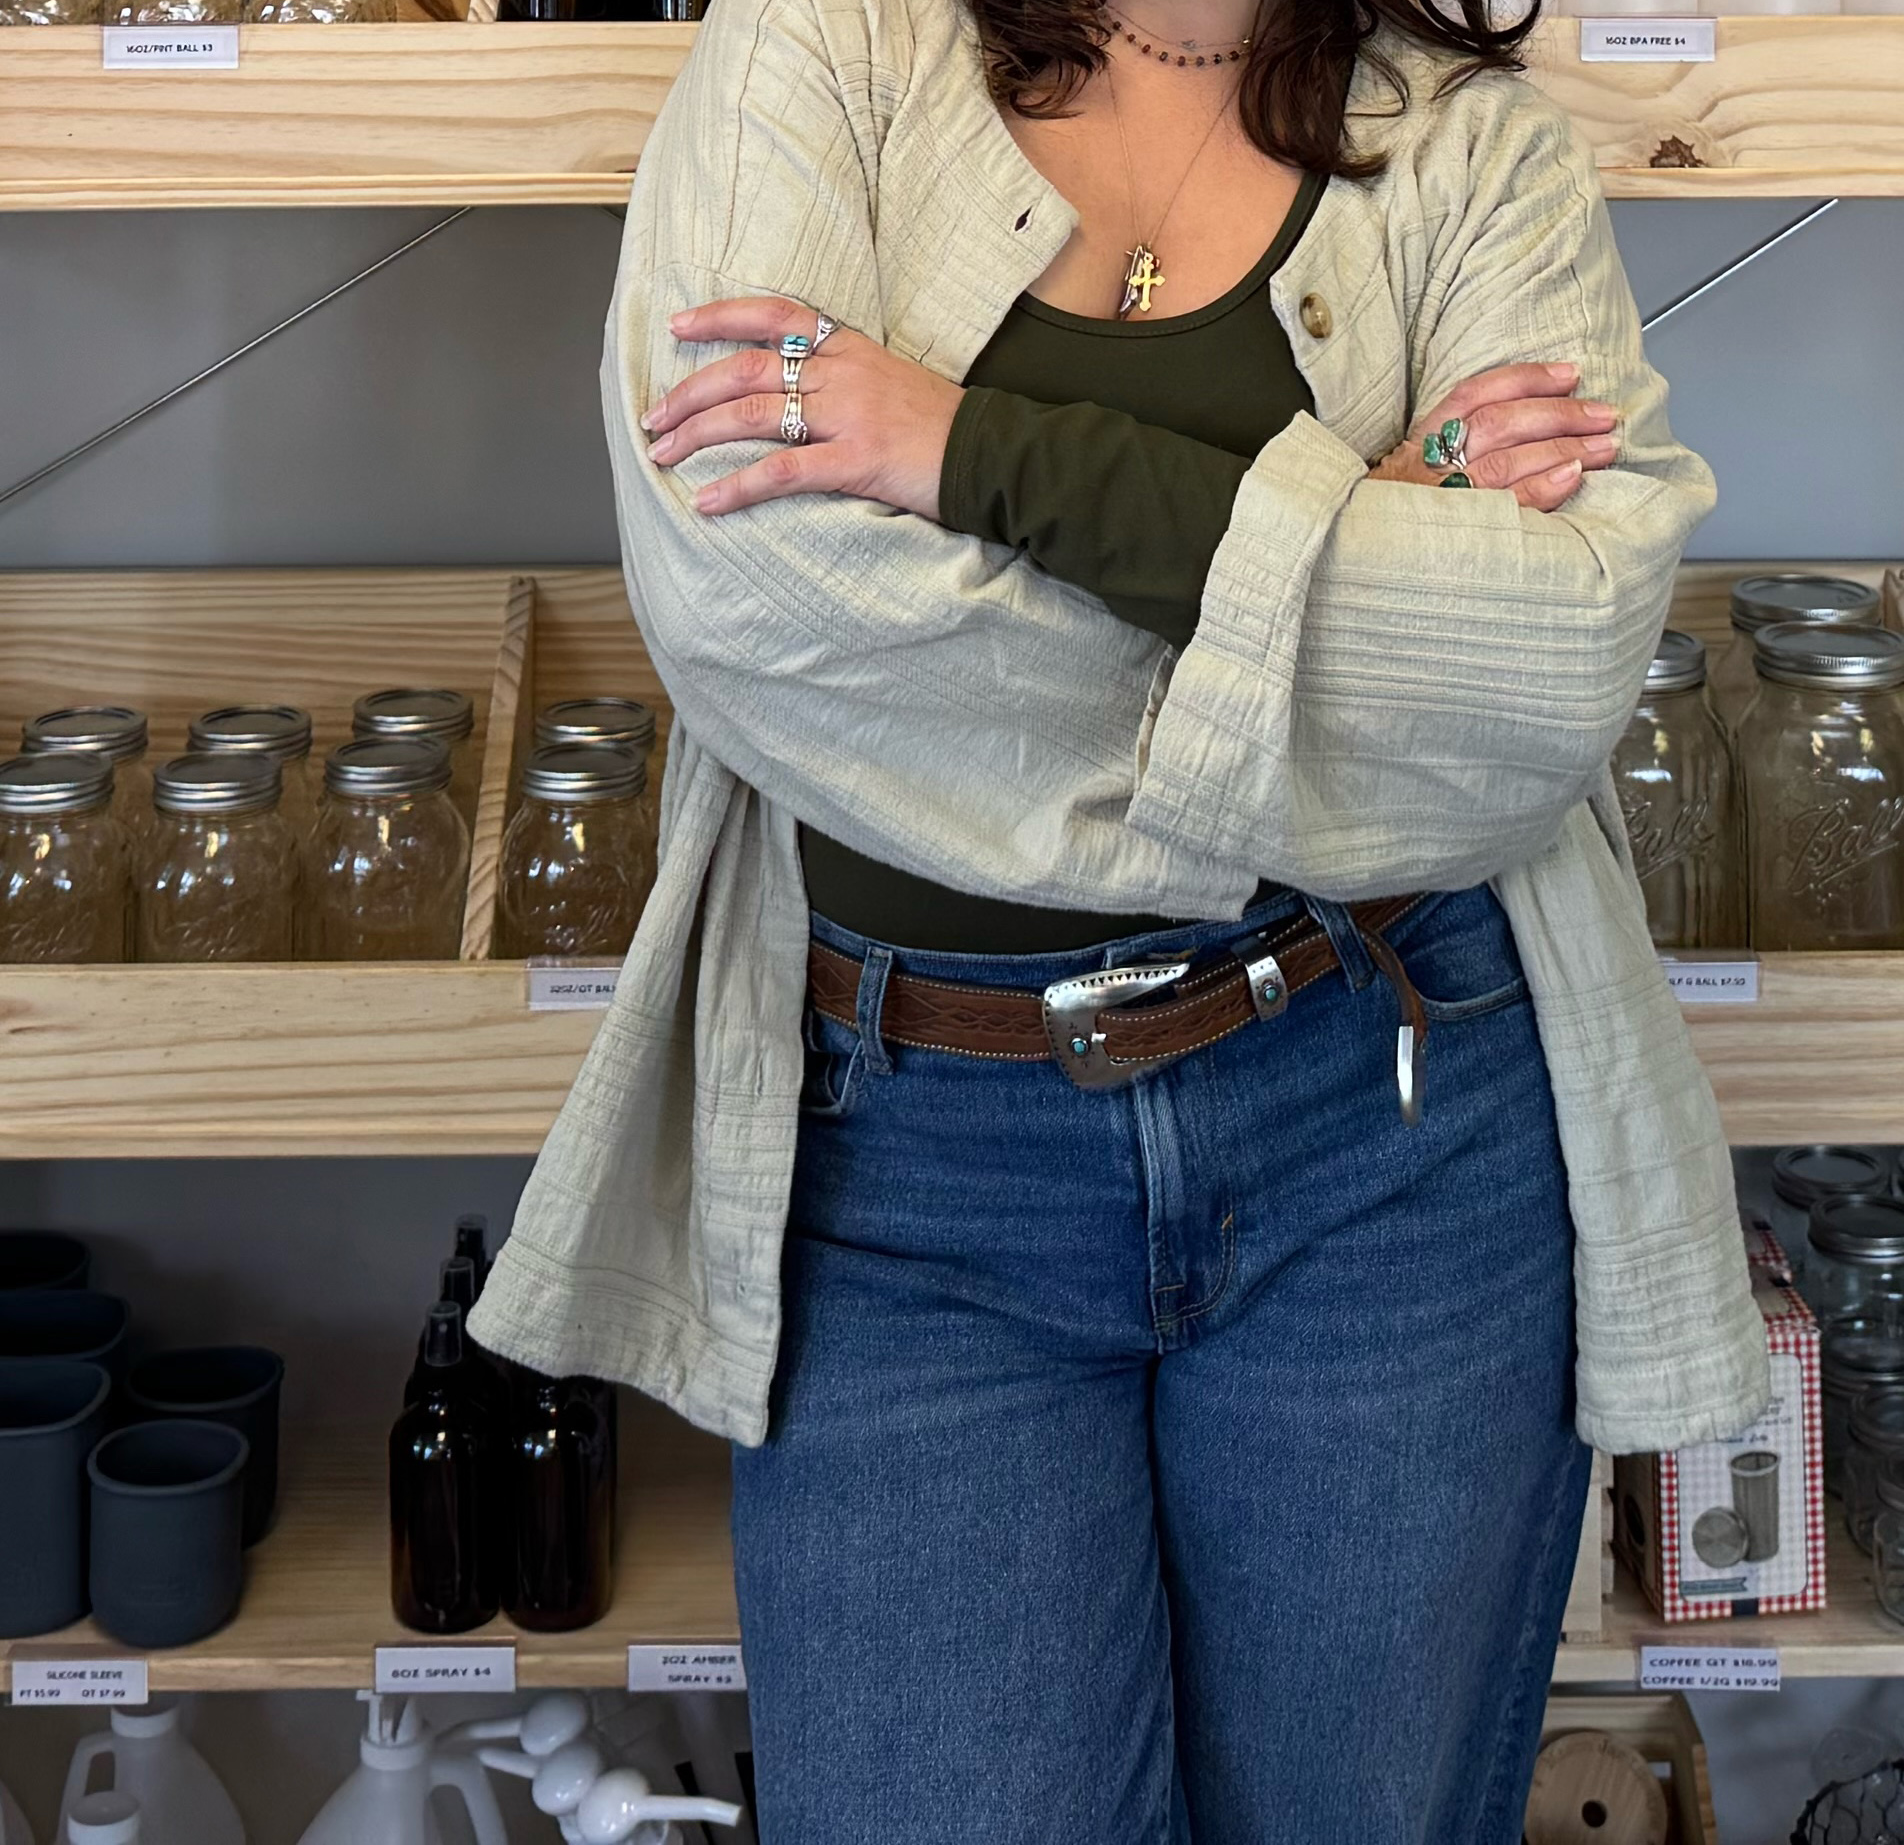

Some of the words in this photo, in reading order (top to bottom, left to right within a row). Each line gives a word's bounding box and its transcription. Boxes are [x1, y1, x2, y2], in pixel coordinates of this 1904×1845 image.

[1650, 36, 1672, 45] FREE
[176, 44, 199, 53] BALL
[1649, 1657, 1701, 1667] COFFEE
[425, 1667, 468, 1679] SPRAY
[1643, 1676, 1695, 1685] COFFEE
